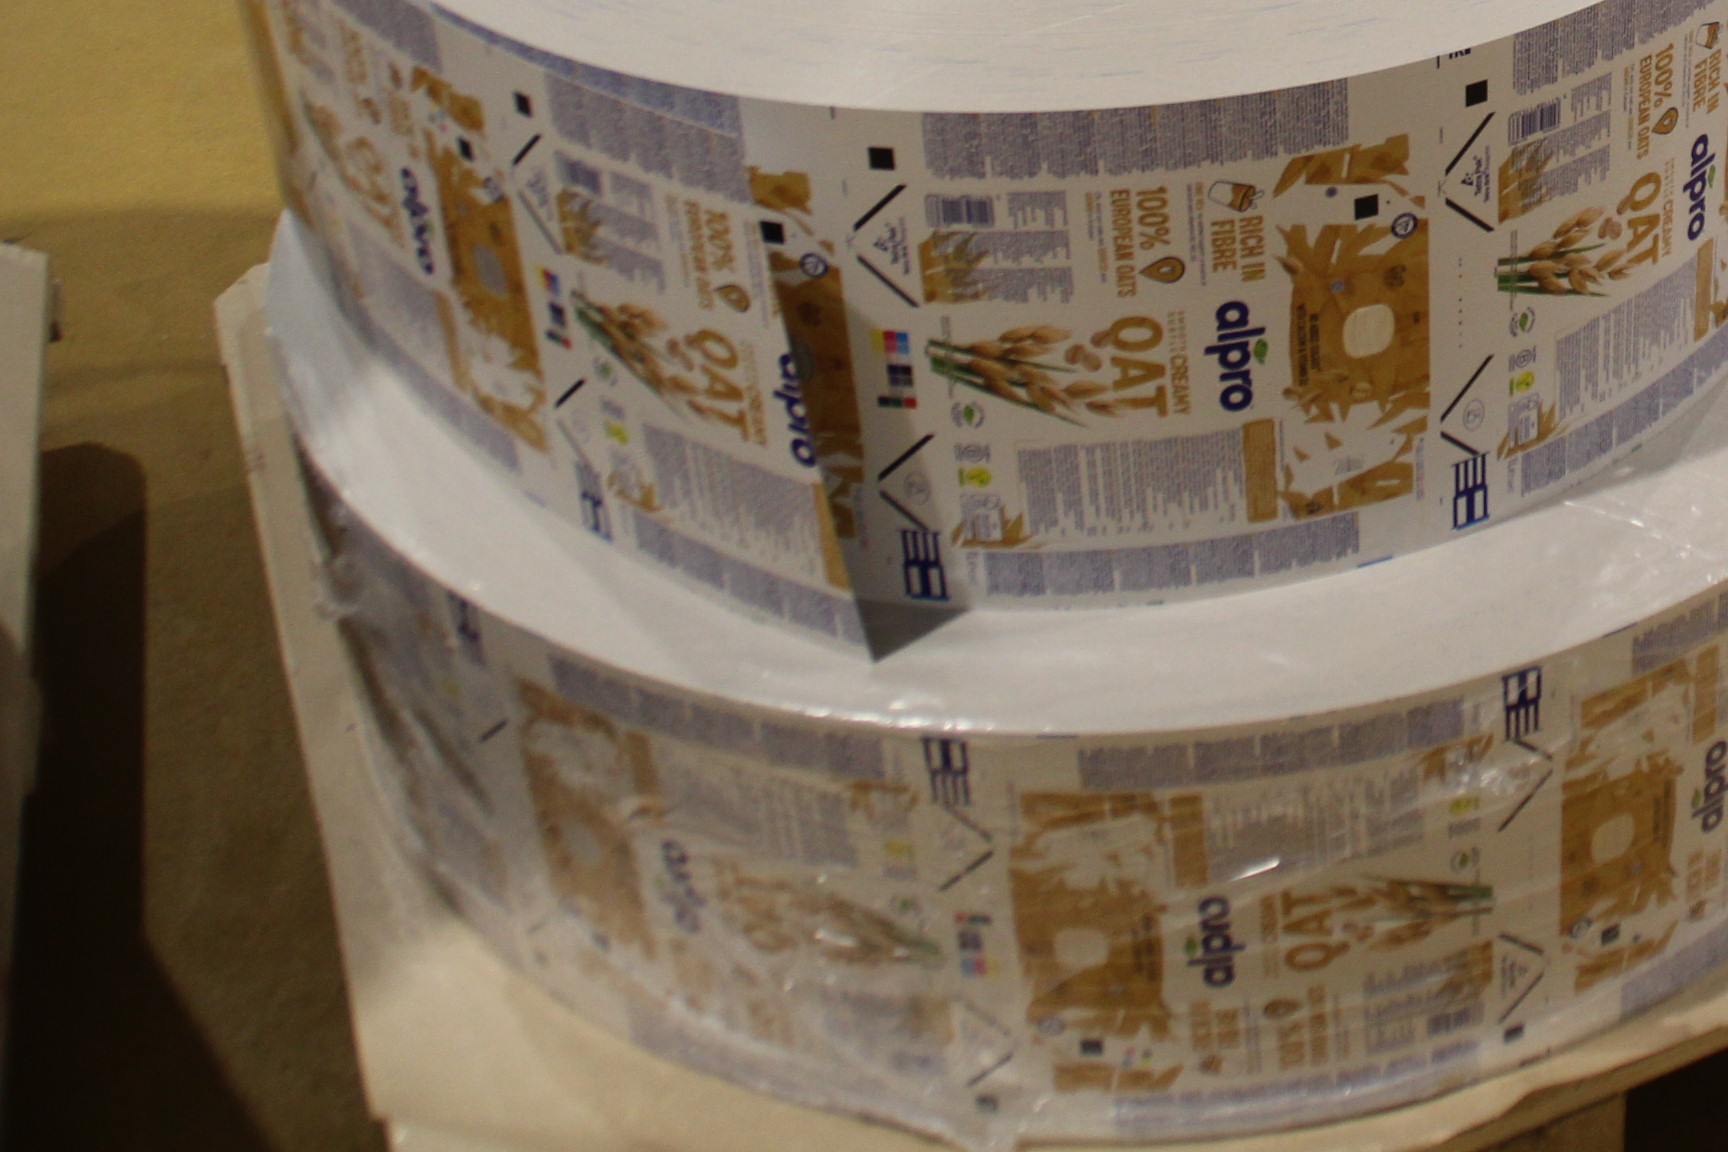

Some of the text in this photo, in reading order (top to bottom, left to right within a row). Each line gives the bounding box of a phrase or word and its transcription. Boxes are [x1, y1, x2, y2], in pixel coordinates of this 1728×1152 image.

[1635, 55, 1653, 160] EUROPEAN OATS
[1652, 43, 1675, 108] 100%
[1691, 61, 1709, 112] FIBRE
[1703, 50, 1722, 114] RICH IN
[1136, 186, 1171, 250] 100%
[1625, 171, 1662, 266] OAT
[1661, 199, 1675, 258] CREAMY
[1683, 133, 1716, 241] alpro
[1109, 189, 1137, 298] EUROPEAN OATS
[1210, 219, 1237, 273] FIBRE
[1239, 215, 1267, 283] RICH IN
[691, 329, 750, 440] OAT
[1109, 316, 1168, 417] OAT
[1169, 355, 1191, 415] CREAMY
[1203, 301, 1267, 412] alpro
[1186, 896, 1246, 988] alpro
[1281, 890, 1332, 973] OAT
